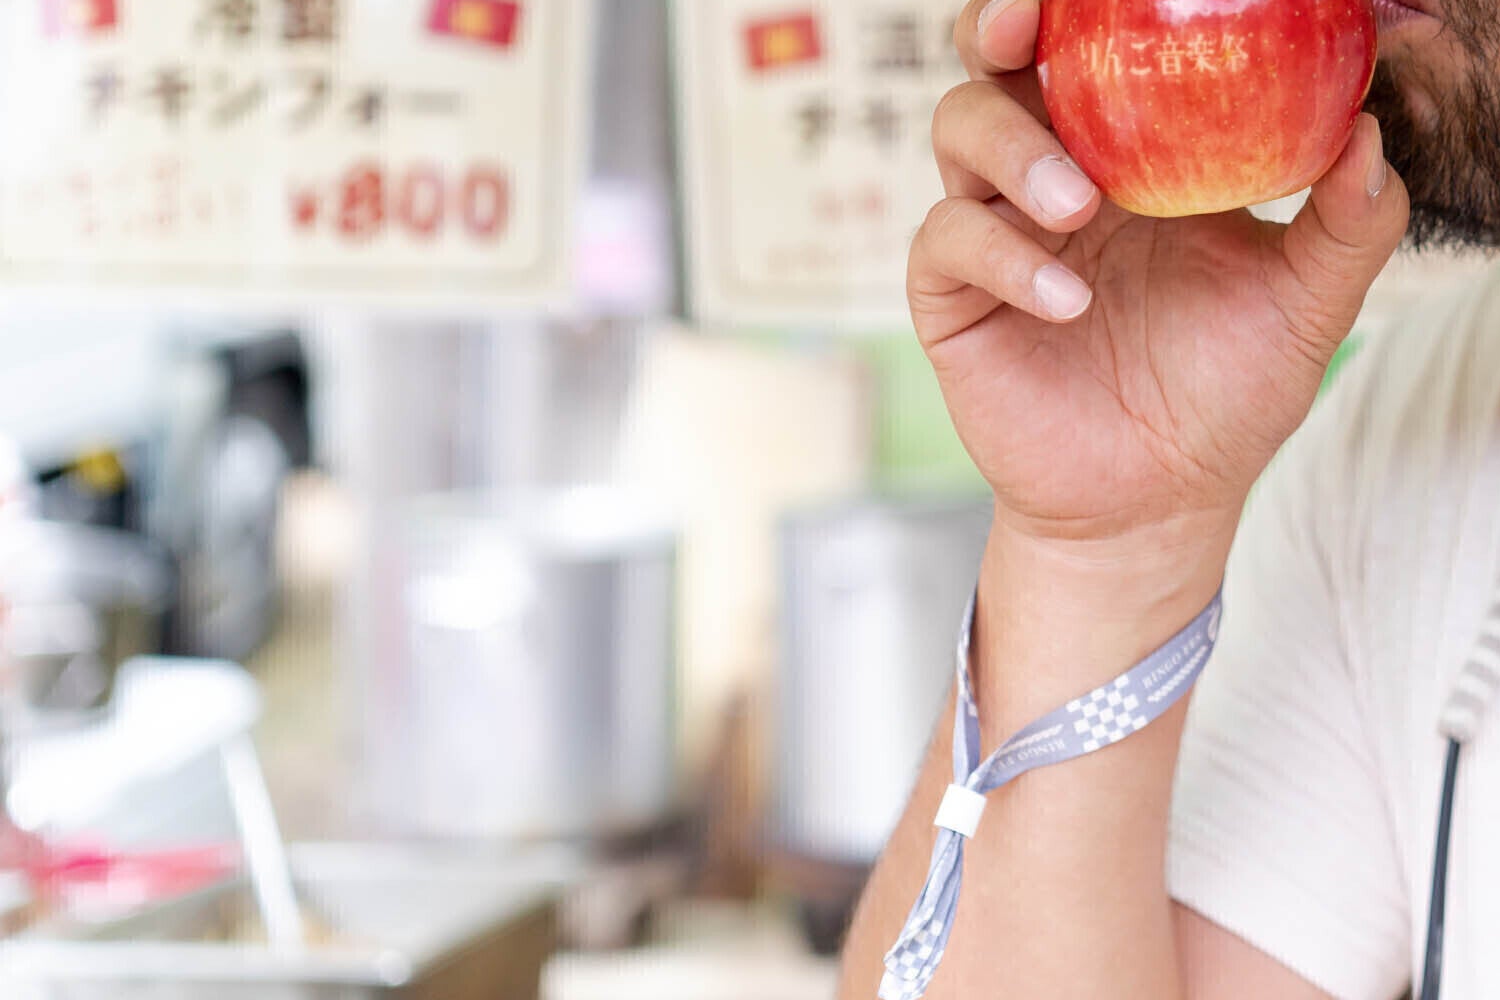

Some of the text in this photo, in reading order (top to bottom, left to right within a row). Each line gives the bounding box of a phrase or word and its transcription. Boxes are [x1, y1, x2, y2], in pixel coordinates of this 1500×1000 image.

[1079, 32, 1250, 77] りんご音楽祭
